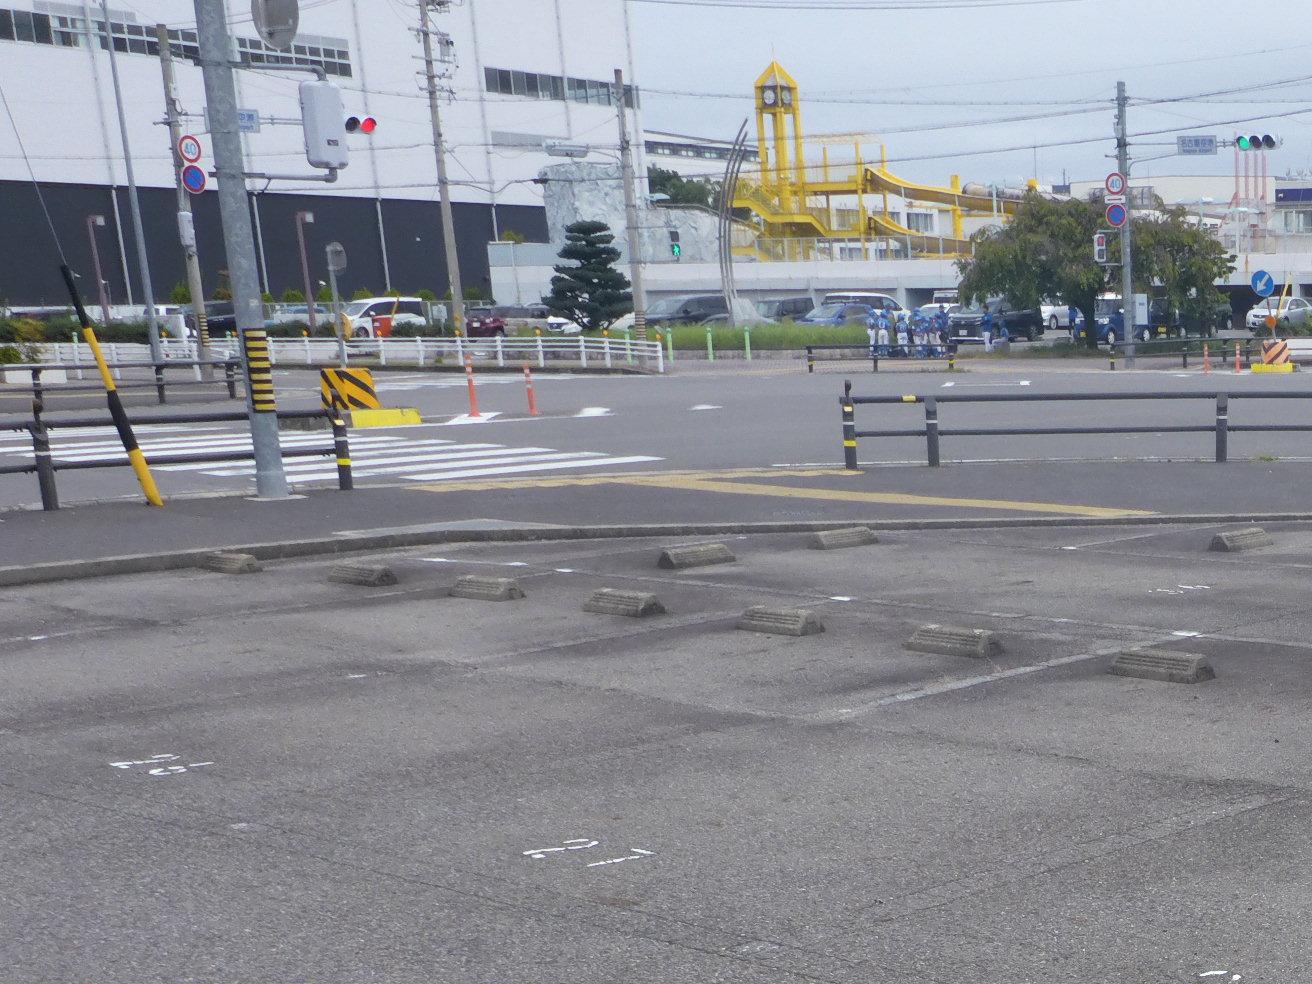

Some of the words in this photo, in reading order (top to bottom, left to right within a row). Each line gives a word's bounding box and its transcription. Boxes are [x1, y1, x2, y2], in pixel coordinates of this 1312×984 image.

[184, 142, 197, 156] 40
[1110, 178, 1121, 189] 40
[523, 838, 657, 867] 27
